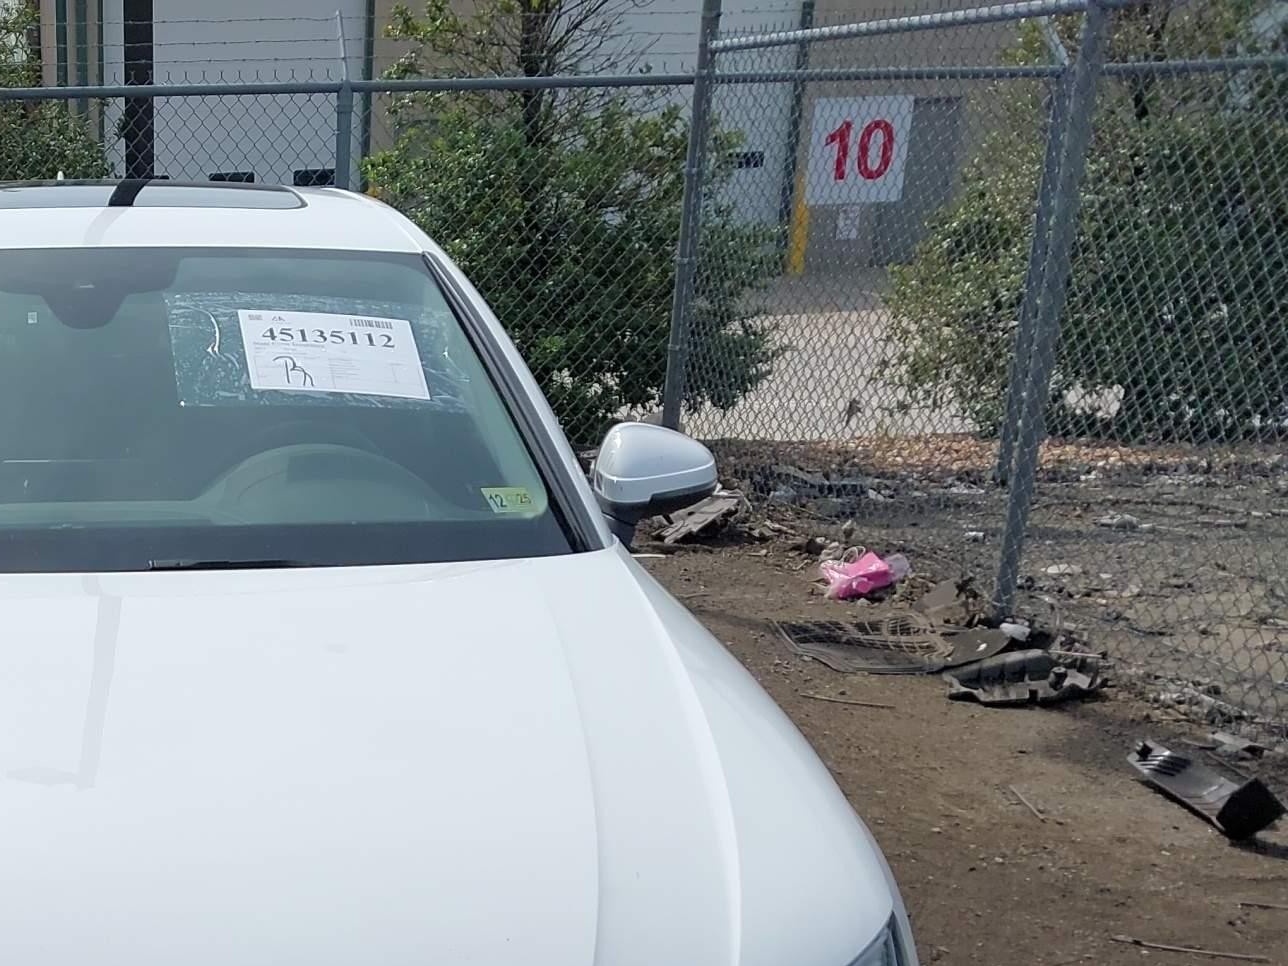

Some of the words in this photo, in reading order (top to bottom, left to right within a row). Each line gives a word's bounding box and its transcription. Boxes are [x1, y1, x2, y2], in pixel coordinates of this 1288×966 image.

[824, 119, 895, 180] 10
[262, 326, 396, 349] 45135112
[489, 493, 508, 508] 12
